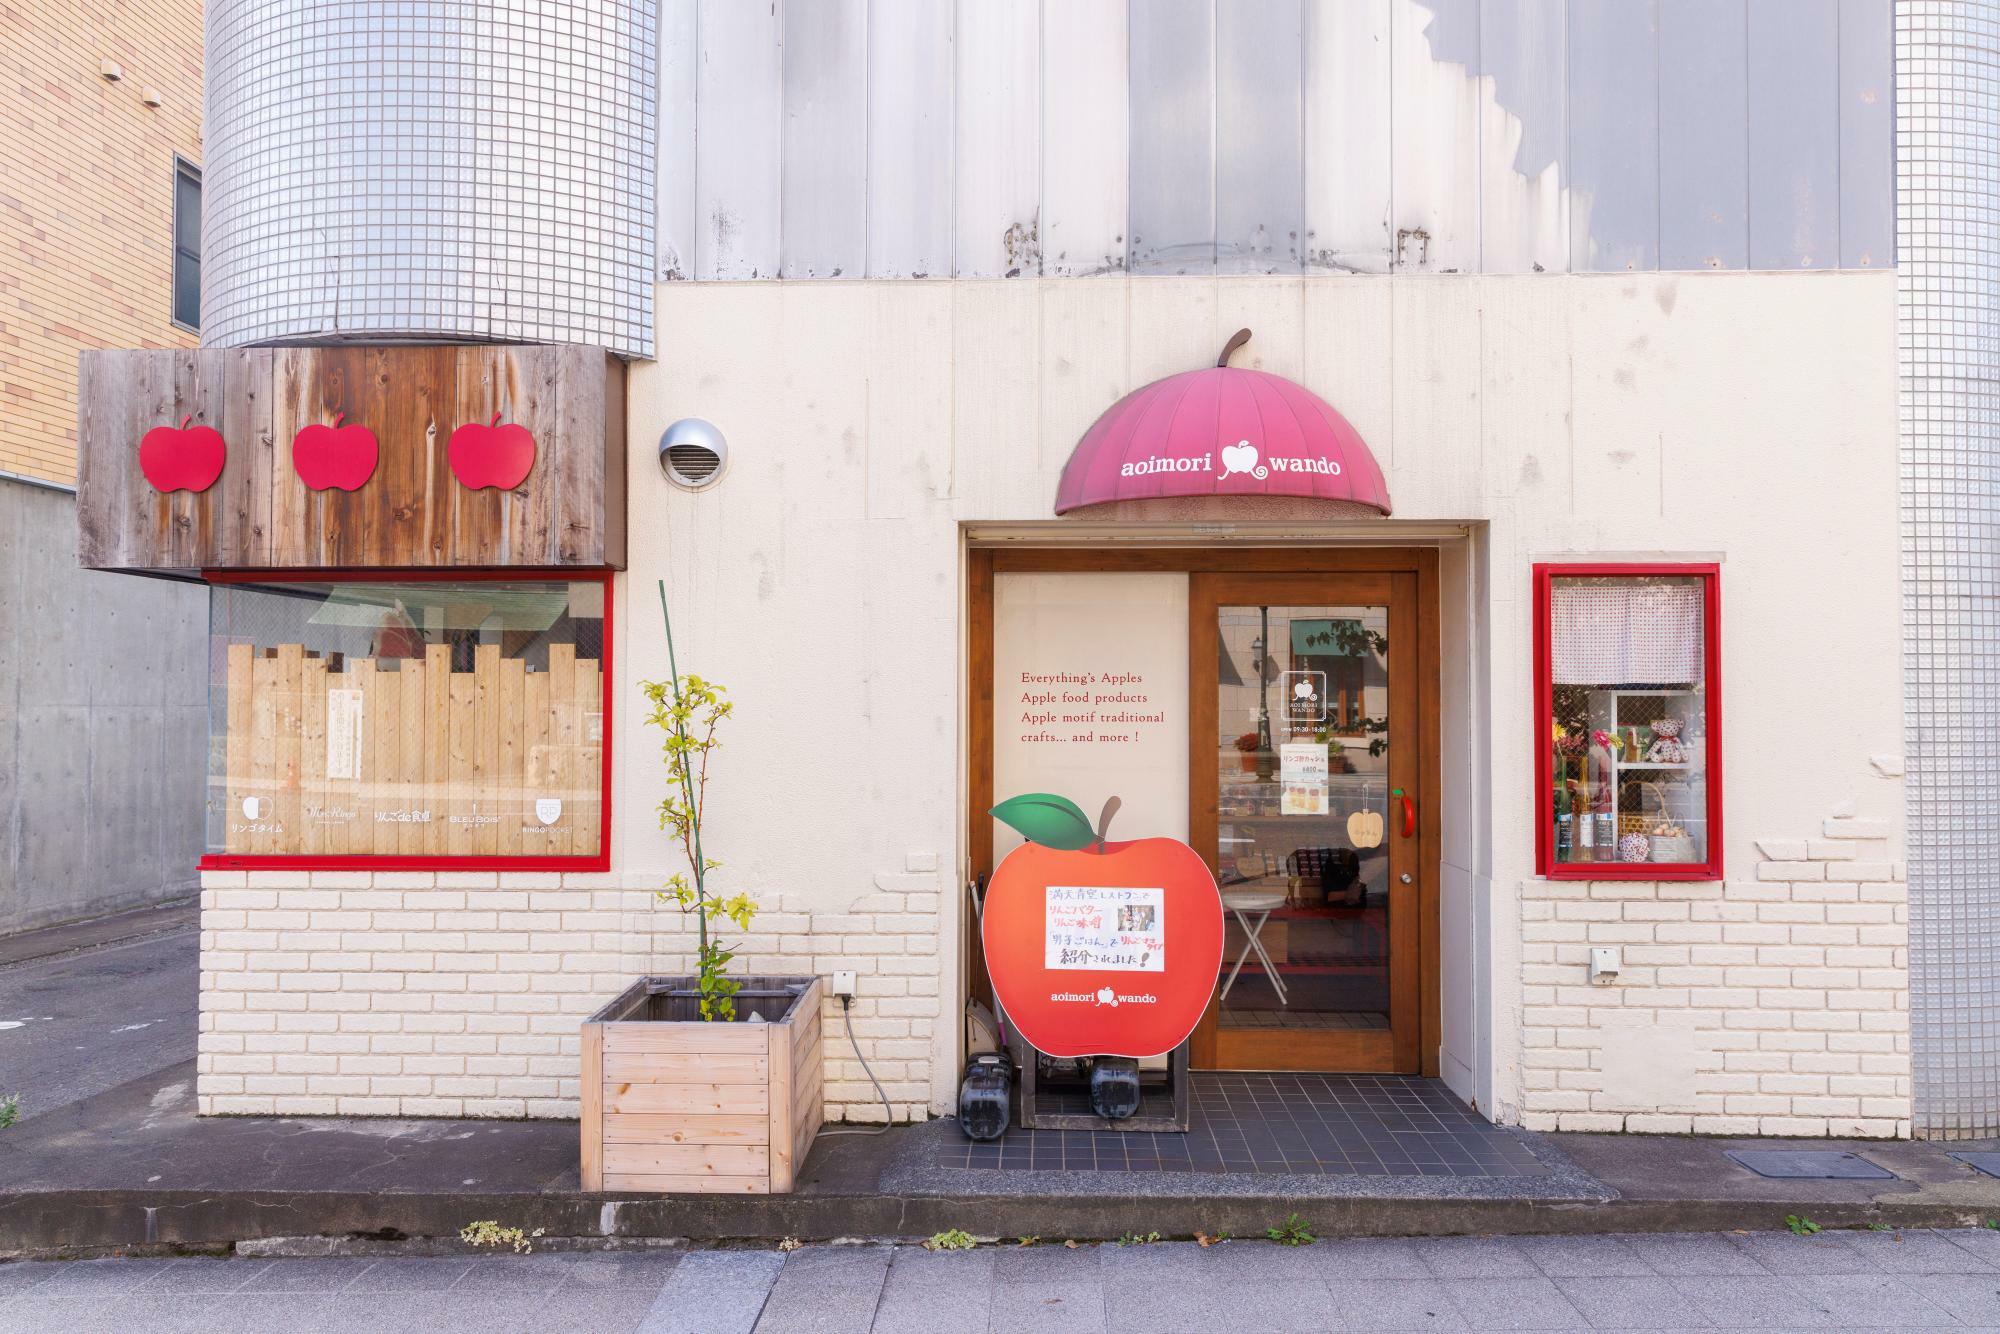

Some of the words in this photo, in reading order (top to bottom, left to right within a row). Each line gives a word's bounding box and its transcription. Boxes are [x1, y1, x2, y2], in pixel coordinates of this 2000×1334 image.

[1121, 452, 1212, 477] aoimori
[1269, 456, 1341, 476] wando
[1021, 671, 1096, 686] Everything's
[1101, 671, 1143, 686] Apples
[1021, 691, 1057, 706] Apple
[1062, 691, 1089, 703] food
[1095, 691, 1148, 706] products
[1021, 711, 1057, 726] Apple
[1062, 711, 1096, 723] motif
[1100, 711, 1164, 723] traditional
[1072, 731, 1093, 742] and
[1100, 734, 1129, 742] more
[232, 823, 283, 833] リンゴタイム
[1051, 991, 1095, 1002] aoimori
[1117, 993, 1157, 1003] wando
